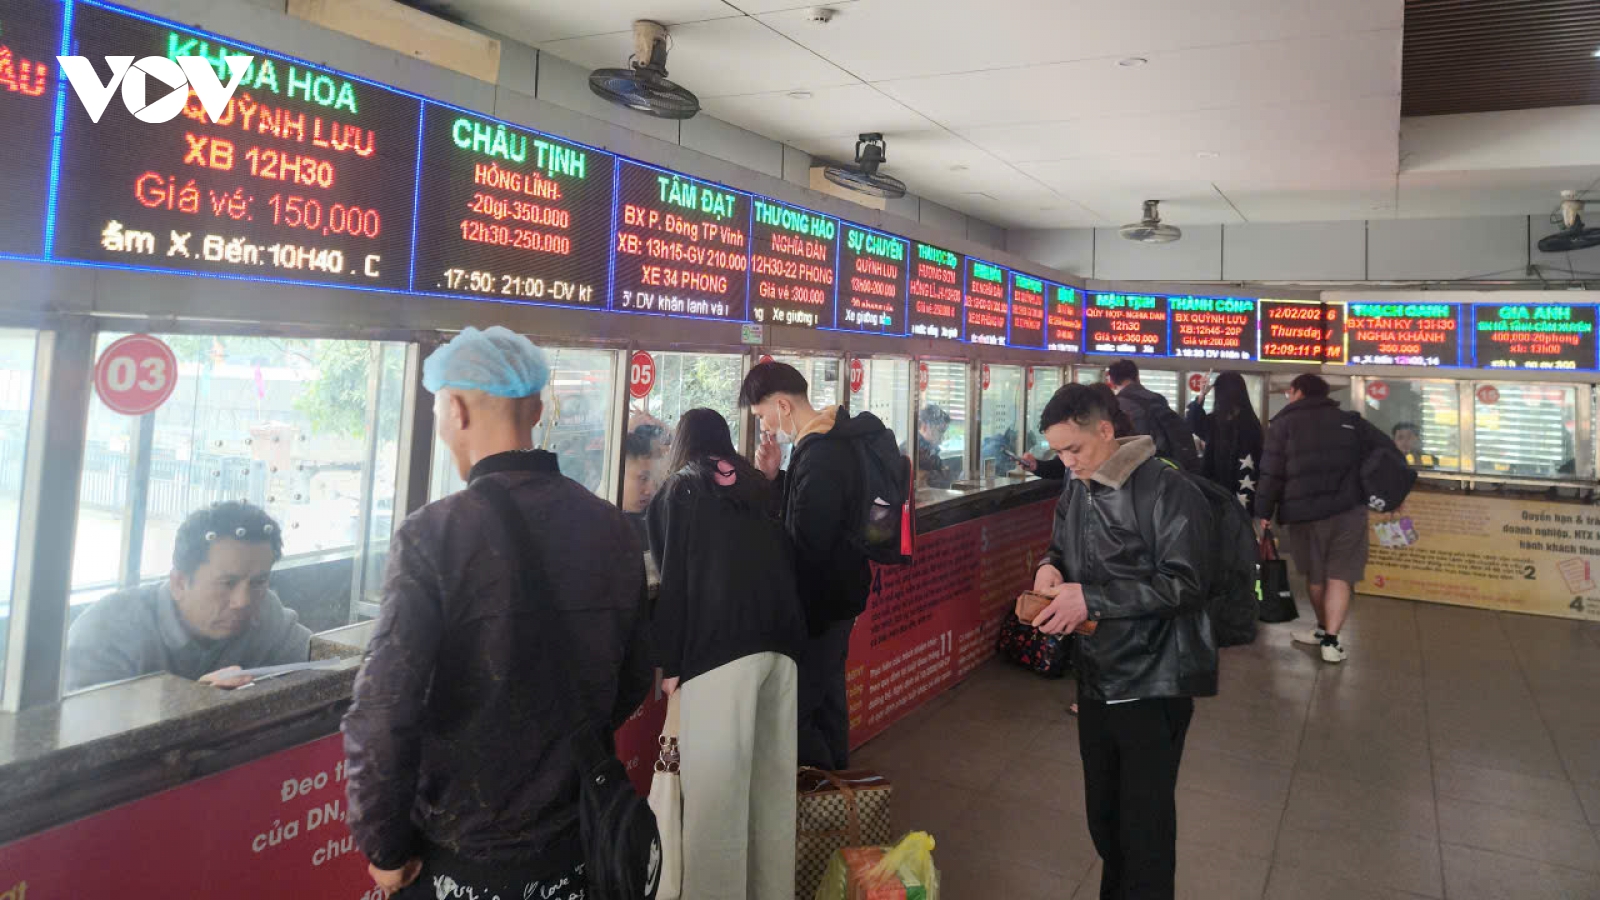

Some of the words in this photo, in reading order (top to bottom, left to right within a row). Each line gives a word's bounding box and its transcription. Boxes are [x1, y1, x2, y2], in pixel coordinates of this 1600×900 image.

[289, 66, 358, 114] HOA
[312, 115, 376, 158] LƯU
[452, 118, 528, 163] CHÂU
[534, 139, 587, 179] TỊNH
[184, 131, 235, 171] XB
[245, 147, 335, 188] 12H30
[475, 161, 521, 192] HỒNG
[134, 171, 201, 214] Giá
[268, 194, 382, 239] 150,000
[657, 174, 697, 210] TÂM
[700, 188, 736, 221] ĐẠT
[460, 219, 571, 255] 12h30-250.000
[624, 204, 646, 227] BX
[665, 214, 699, 242] Đông
[701, 221, 719, 241] TP
[719, 225, 745, 247] Vinh
[617, 232, 643, 255] XB:
[645, 237, 706, 265] 13h15-GV
[706, 249, 747, 272] 210.000
[771, 233, 805, 257] NGHĨA
[805, 240, 828, 262] ĐÀN
[641, 264, 661, 286] XE
[663, 268, 679, 288] 34
[680, 271, 728, 294] PHONG
[751, 254, 797, 280] 12H30-22
[501, 274, 544, 297] 21:00
[759, 281, 776, 299] Giá
[772, 306, 785, 321] Xe
[1168, 296, 1214, 312] THÀNH
[1175, 313, 1191, 323] BX
[1190, 311, 1226, 325] QUỲNH
[1226, 314, 1248, 326] LƯU
[1110, 319, 1141, 331] 12h30
[1416, 319, 1457, 331] 13H30
[1263, 343, 1312, 356] 12:09:11
[108, 356, 166, 392] 03
[630, 364, 651, 385] 05
[851, 368, 862, 383] 07
[1373, 574, 1386, 589] 3
[1523, 564, 1536, 580] 2
[1569, 595, 1585, 612] 4
[281, 771, 329, 802] Đeo
[251, 818, 300, 853] của
